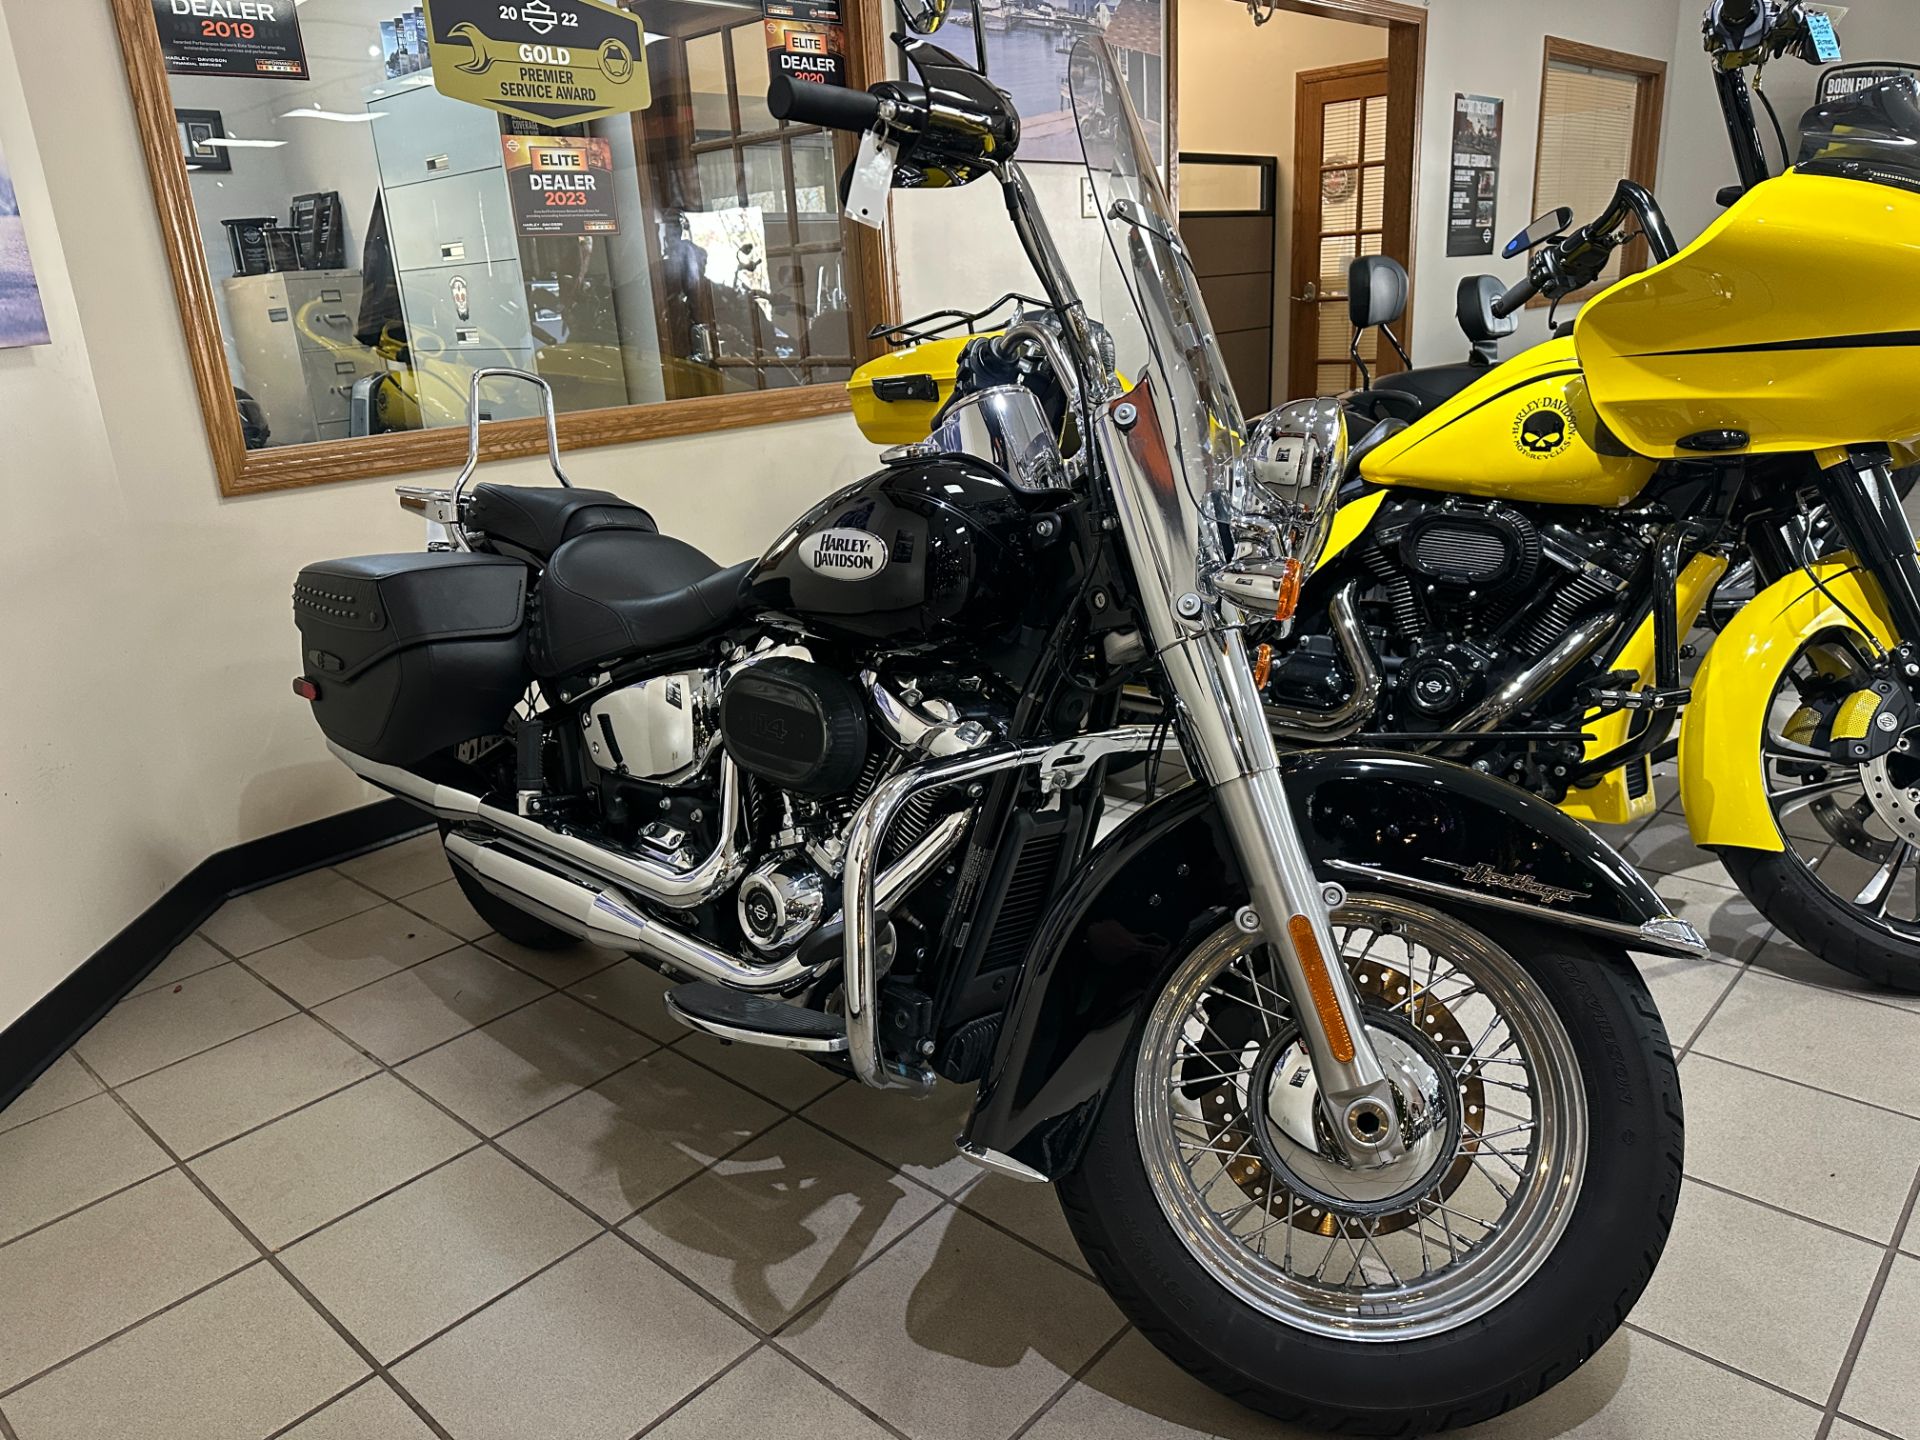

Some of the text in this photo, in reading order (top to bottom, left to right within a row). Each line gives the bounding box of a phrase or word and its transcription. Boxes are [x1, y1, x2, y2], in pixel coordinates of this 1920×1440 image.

[170, 0, 277, 21] DEALER
[499, 5, 579, 28] 20 22
[201, 20, 256, 39] 2019
[791, 37, 822, 50] ELITE
[518, 44, 571, 65] GOLD
[780, 54, 836, 72] DEALER
[519, 67, 575, 85] PREMIER
[1826, 77, 1855, 94] BORN
[1855, 76, 1873, 93] FOR
[500, 82, 596, 101] SERVICE AWARD
[539, 153, 581, 167] ELITE
[529, 174, 597, 191] DEALER
[544, 191, 588, 206] 2023
[1513, 439, 1572, 460] MOTORCYCLES
[813, 550, 874, 570] DAVIDSON
